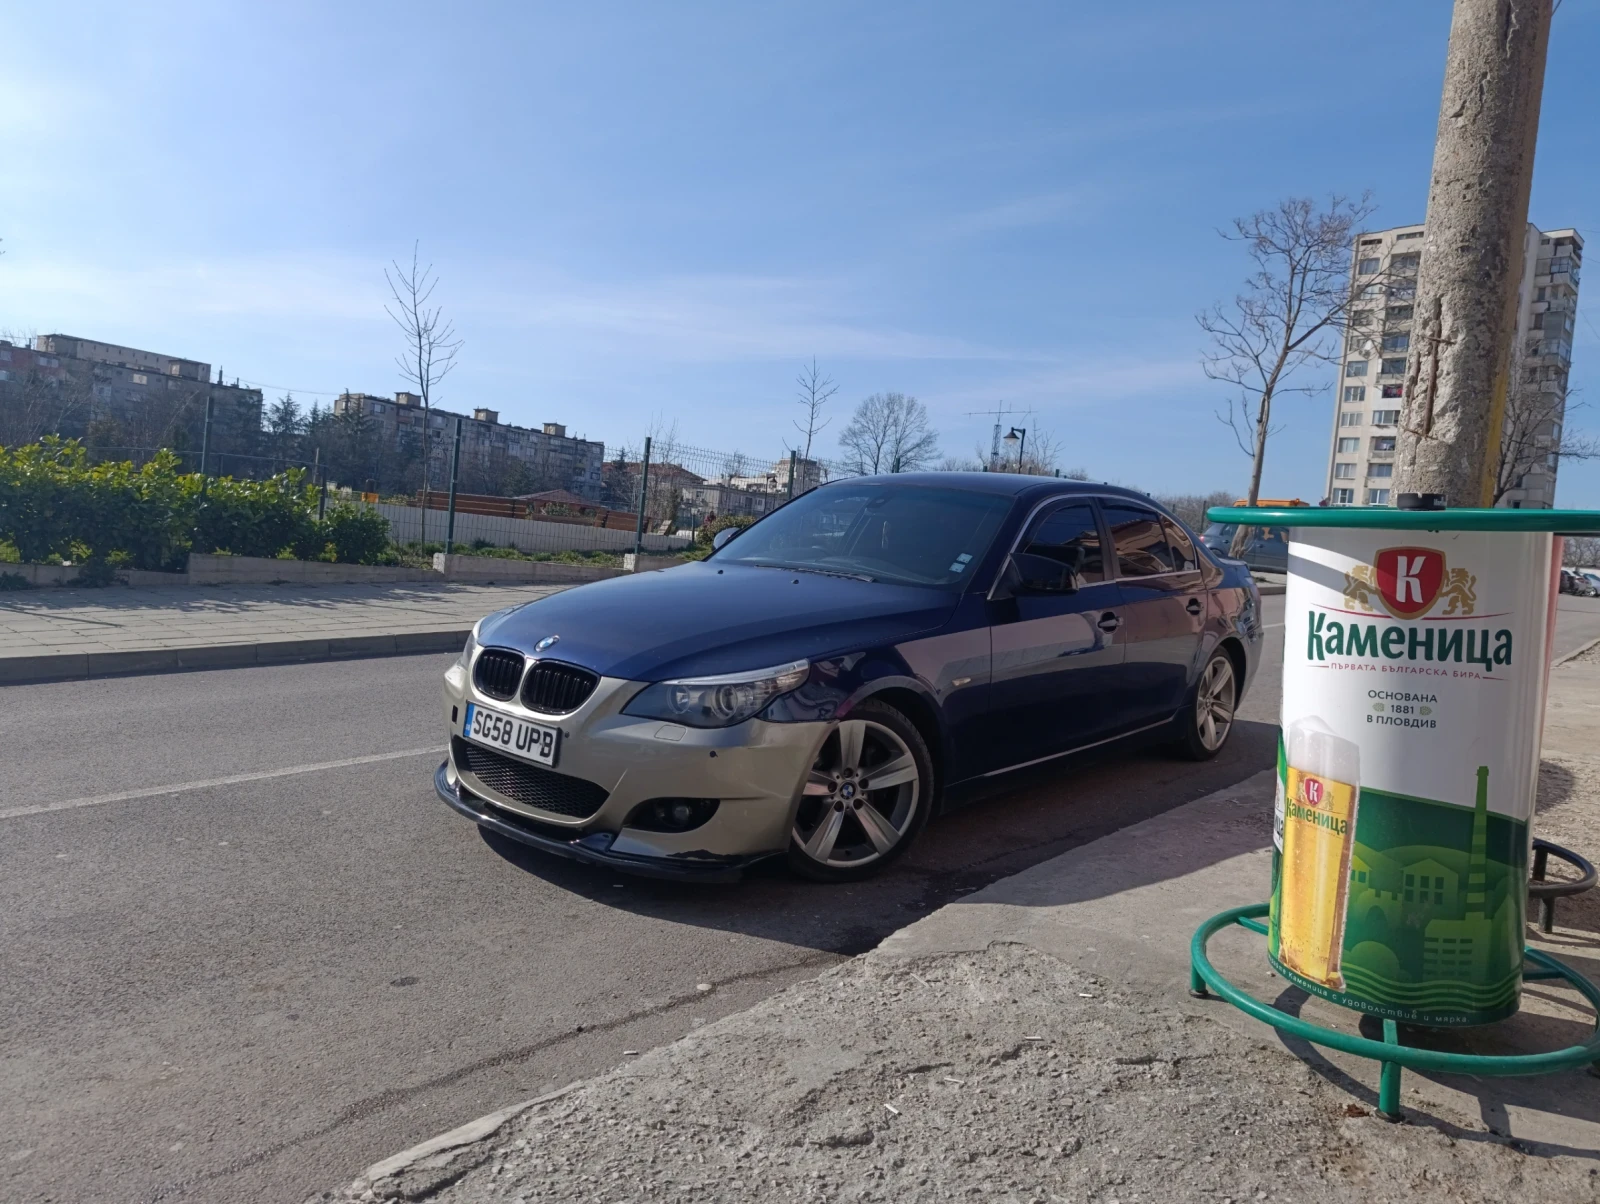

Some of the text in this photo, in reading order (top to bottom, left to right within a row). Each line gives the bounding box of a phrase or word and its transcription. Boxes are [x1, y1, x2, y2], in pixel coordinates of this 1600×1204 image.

[1306, 610, 1514, 673] Каменица
[1330, 662, 1481, 680] ПЪРВАТА БЪЛГАРСКА БИРА
[1367, 689, 1438, 703] ОСНОВАНА
[1390, 704, 1415, 715] 1881
[1366, 714, 1437, 729] В ПЛОВДИВ
[473, 710, 555, 759] SG58 UPB
[1286, 797, 1348, 836] Каменица
[1288, 972, 1328, 997] Каменица
